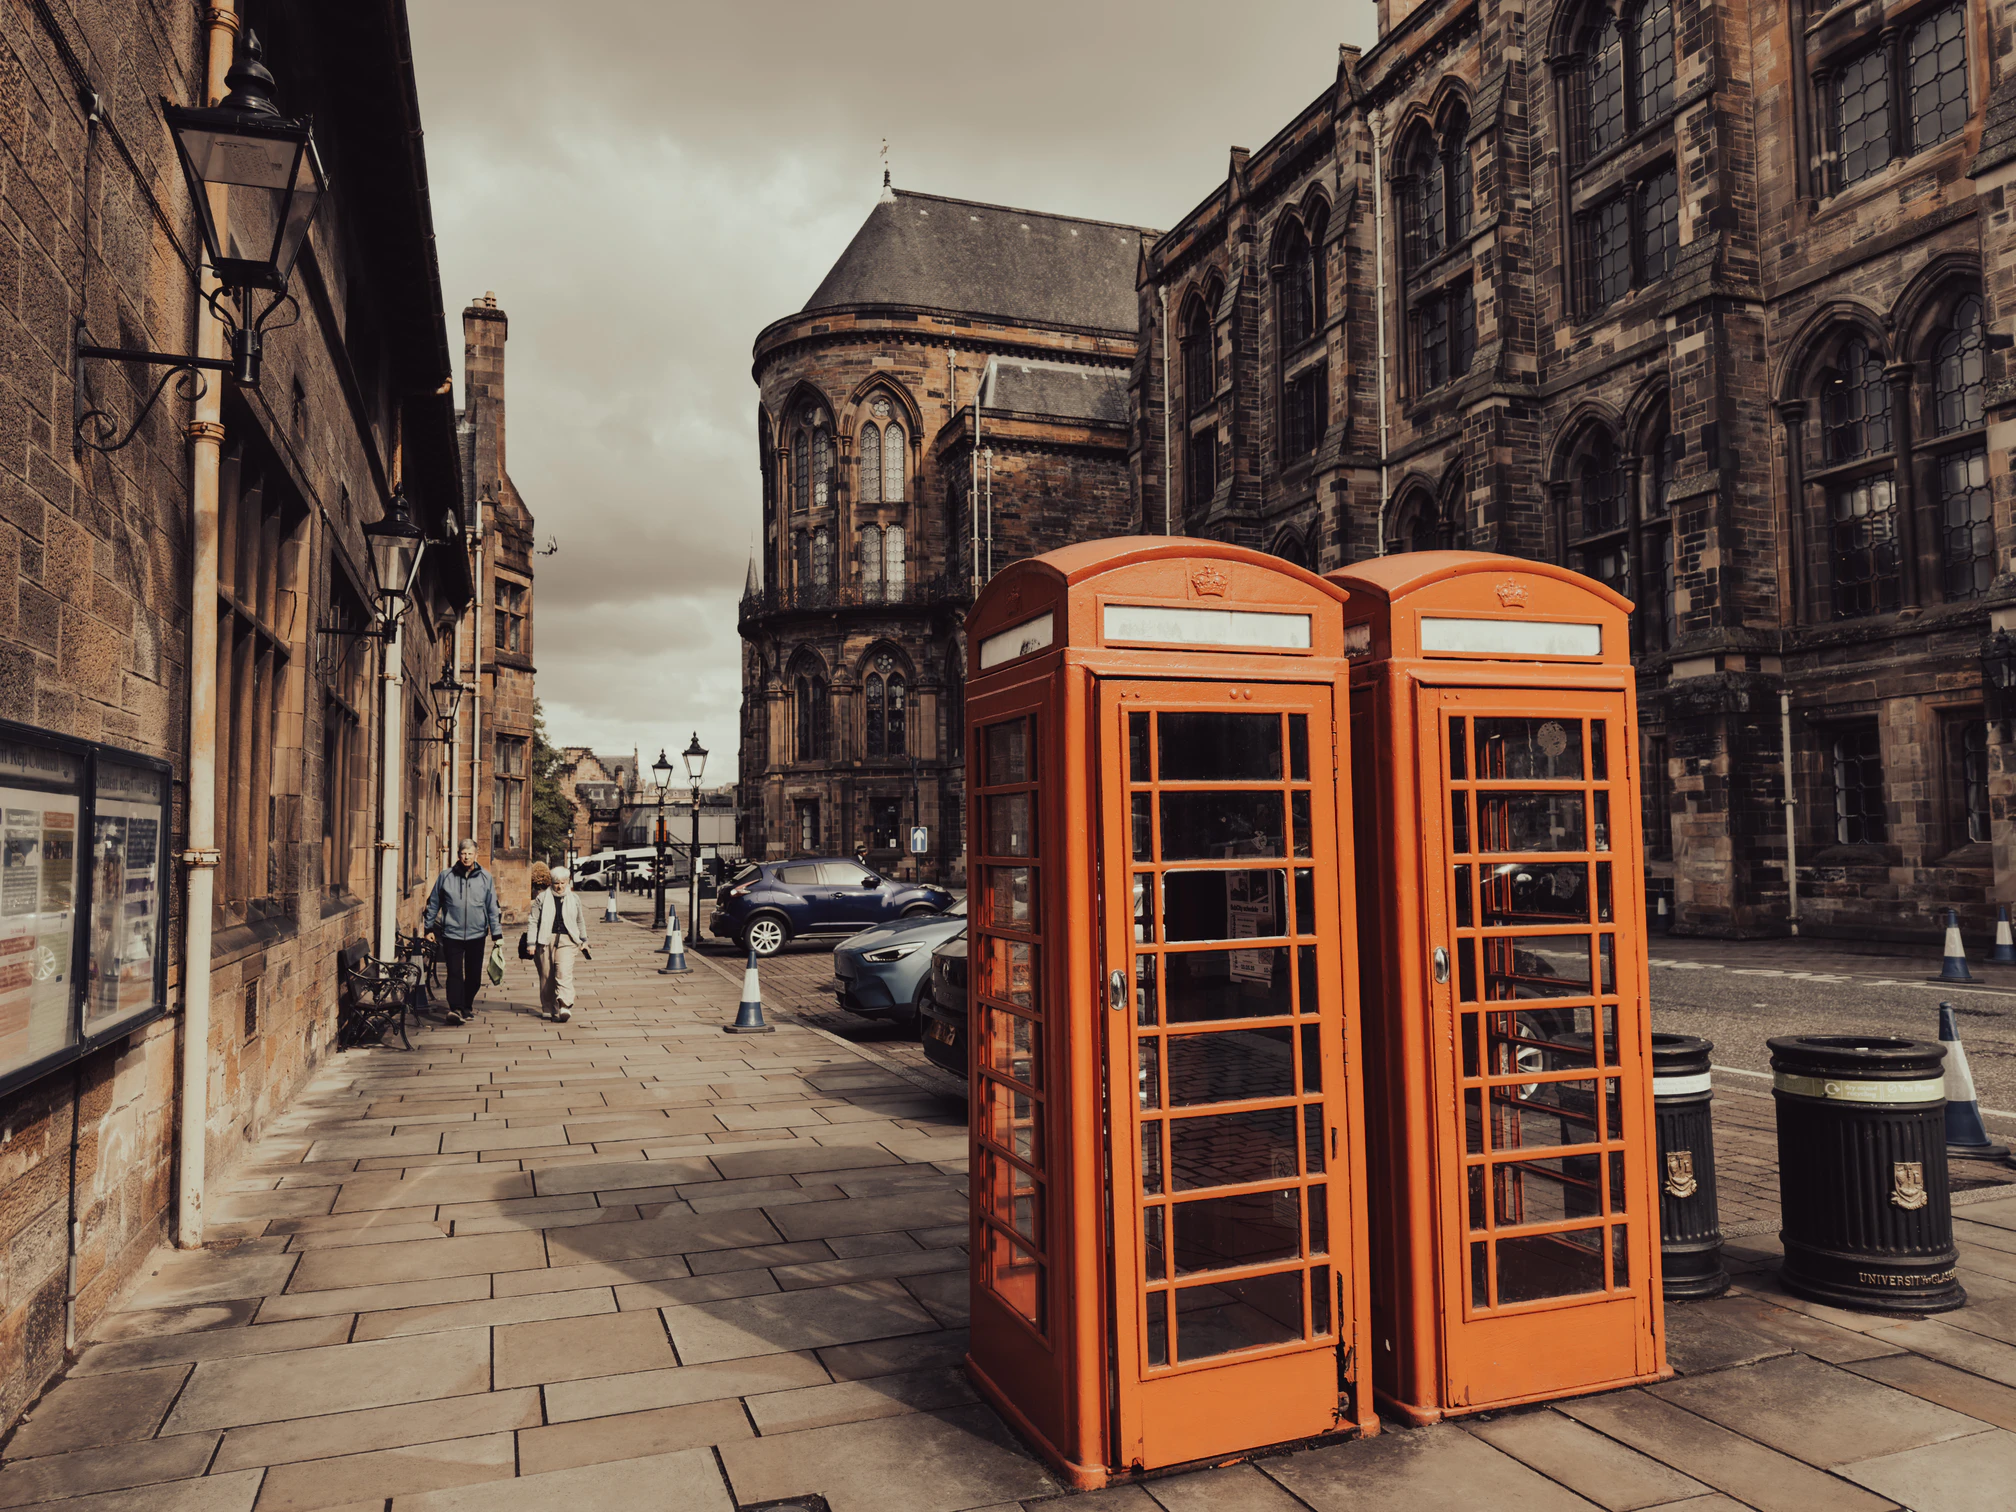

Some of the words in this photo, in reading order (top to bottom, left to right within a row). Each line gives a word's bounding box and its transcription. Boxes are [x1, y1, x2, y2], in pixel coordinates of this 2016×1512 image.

[1844, 1084, 1856, 1092] dry
[1898, 1084, 1914, 1093] Yes
[1846, 1091, 1877, 1099] recycling
[1858, 1272, 1927, 1287] UNIVERSITY
